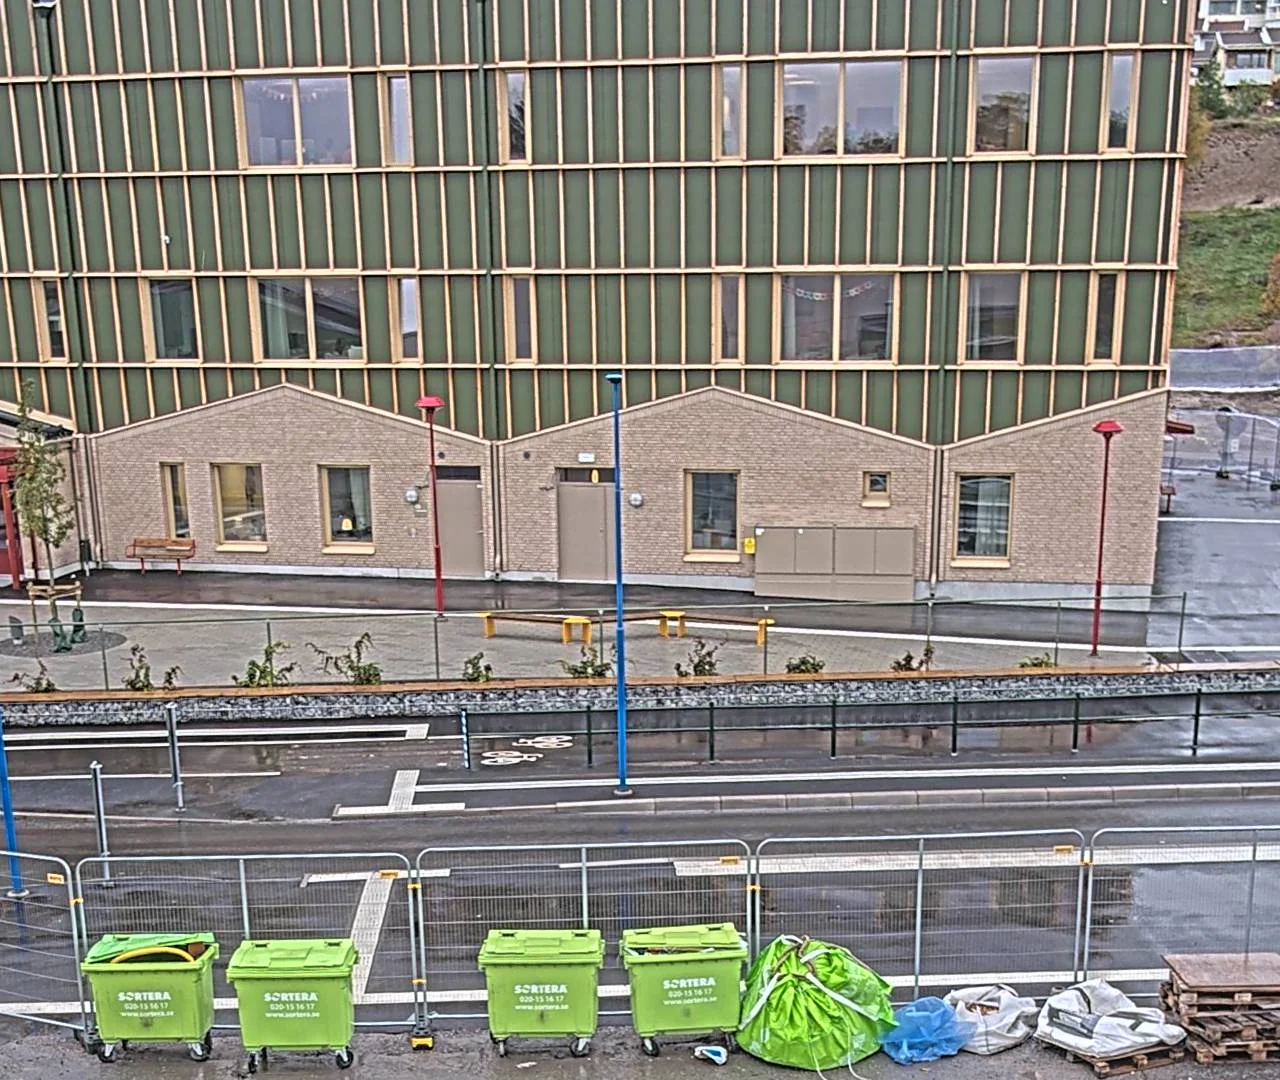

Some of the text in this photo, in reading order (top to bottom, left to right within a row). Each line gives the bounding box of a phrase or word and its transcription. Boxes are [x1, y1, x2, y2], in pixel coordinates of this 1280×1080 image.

[663, 977, 716, 989] SORTERA
[514, 985, 568, 994] SORTERA
[118, 991, 171, 1001] SORTERA
[264, 992, 318, 1002] SORTERA
